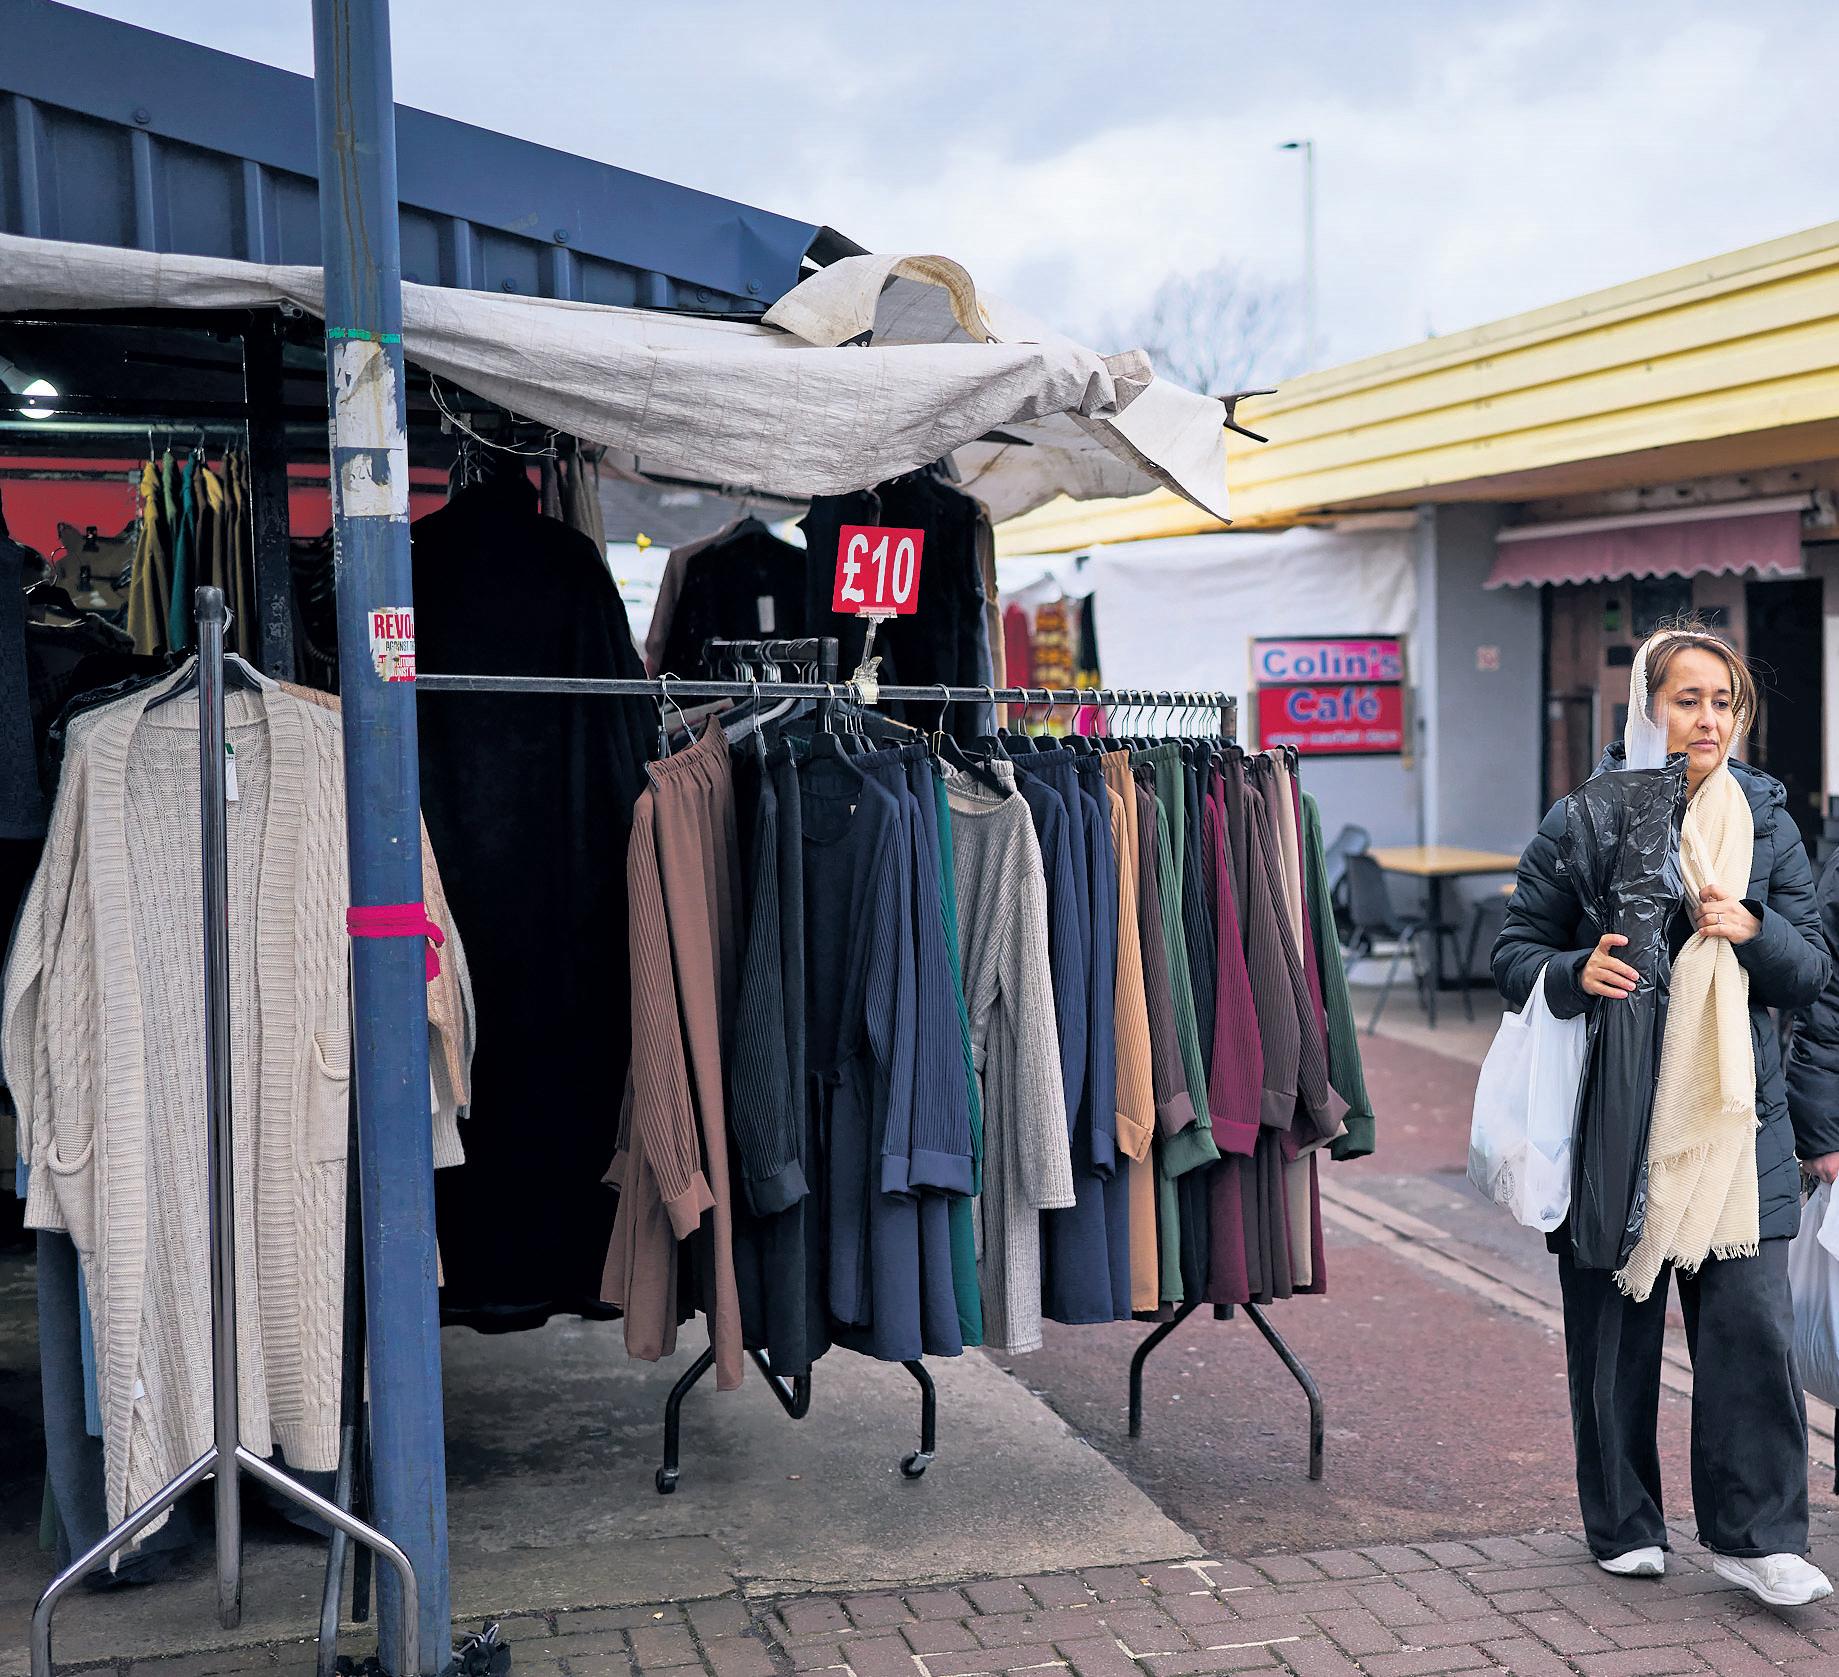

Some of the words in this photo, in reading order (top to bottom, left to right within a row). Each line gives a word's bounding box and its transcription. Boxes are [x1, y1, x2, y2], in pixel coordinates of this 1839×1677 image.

[841, 533, 915, 604] £10
[1263, 647, 1400, 677] Colin's
[1287, 687, 1378, 722] Café
